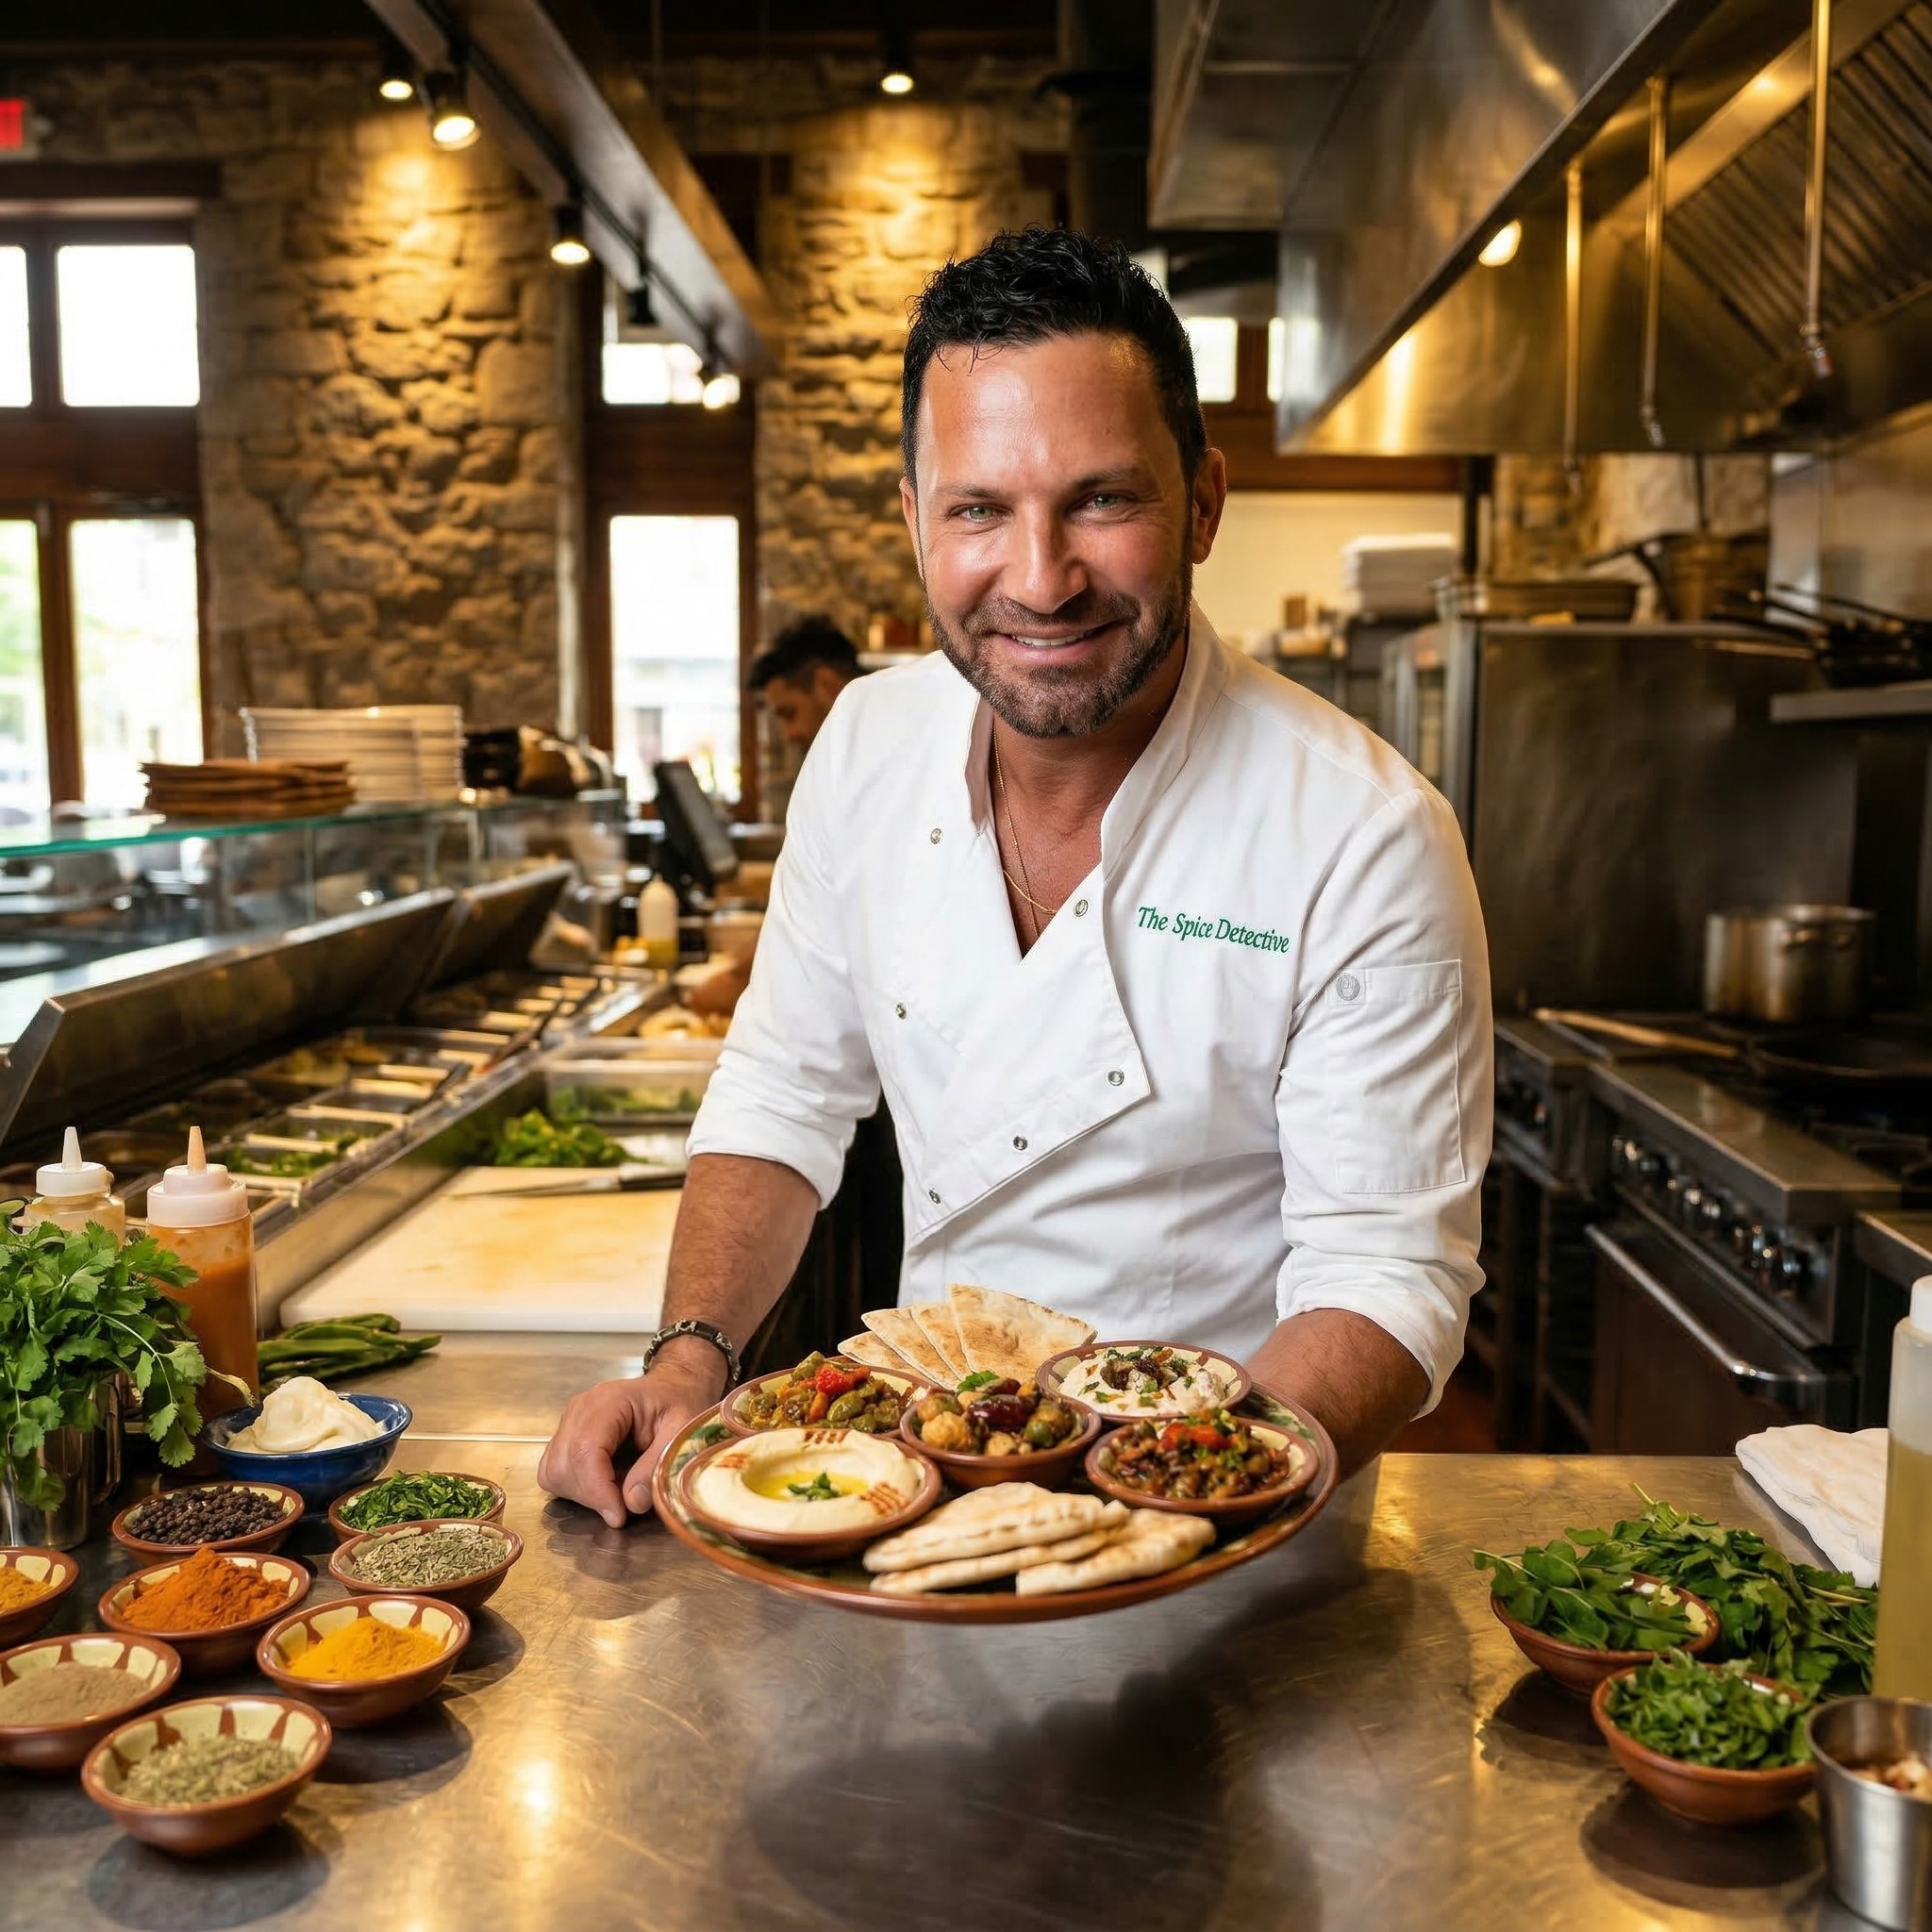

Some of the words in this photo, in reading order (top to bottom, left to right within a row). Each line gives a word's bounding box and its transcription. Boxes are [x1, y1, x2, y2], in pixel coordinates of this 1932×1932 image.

[1139, 907, 1169, 930] The
[1172, 912, 1213, 941] Spice
[1215, 918, 1290, 953] Detective
